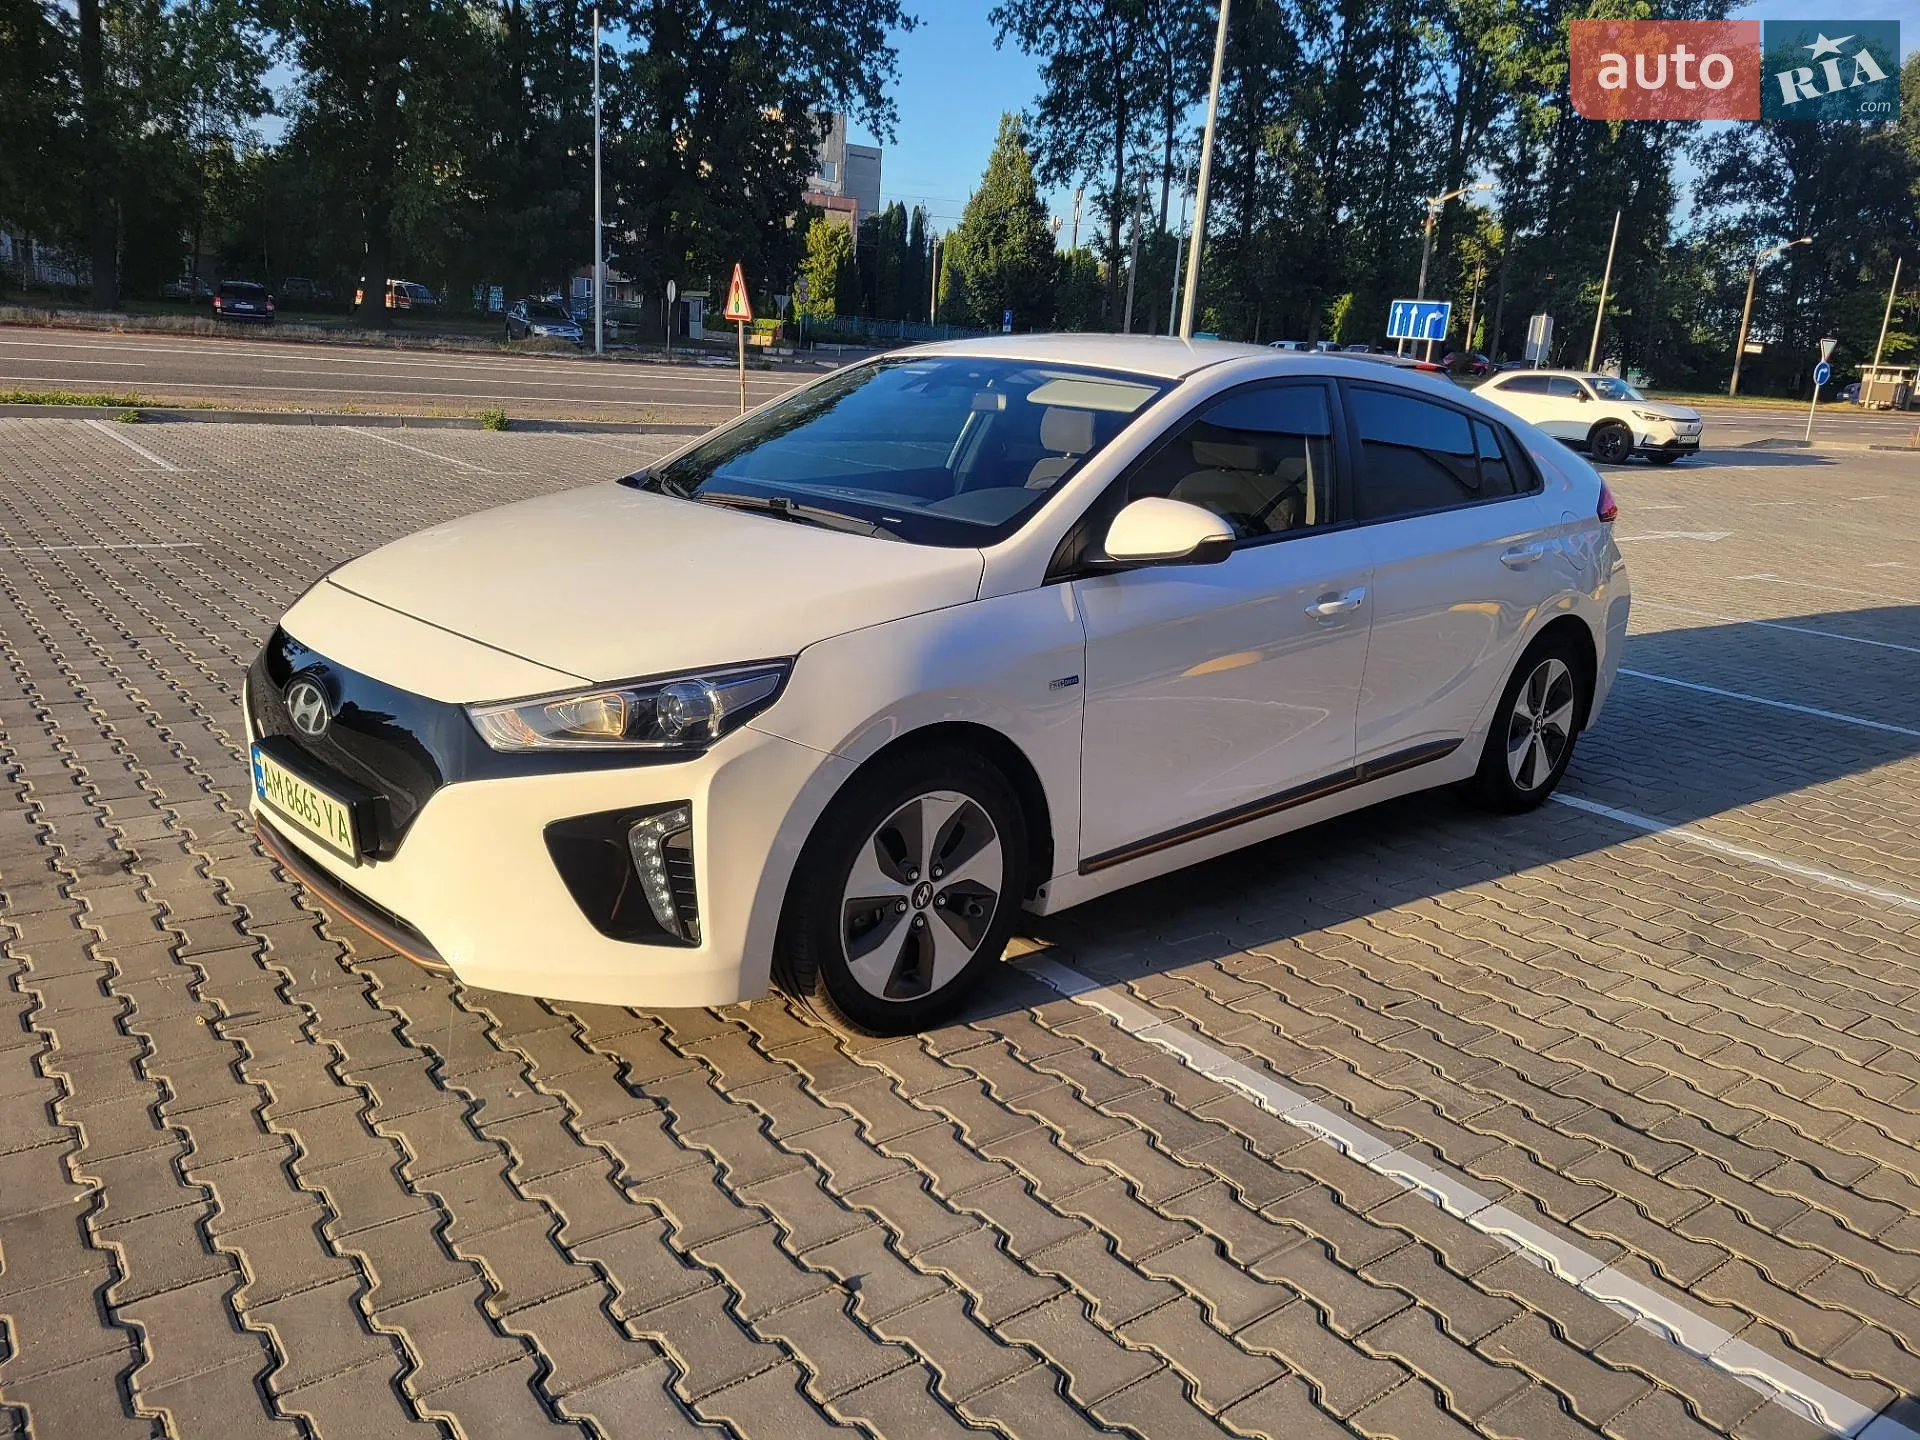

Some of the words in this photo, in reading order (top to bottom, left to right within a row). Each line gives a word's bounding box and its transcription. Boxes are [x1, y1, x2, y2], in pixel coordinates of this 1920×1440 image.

[264, 761, 285, 805] AM
[285, 775, 321, 828] 8665
[322, 799, 351, 848] YA
